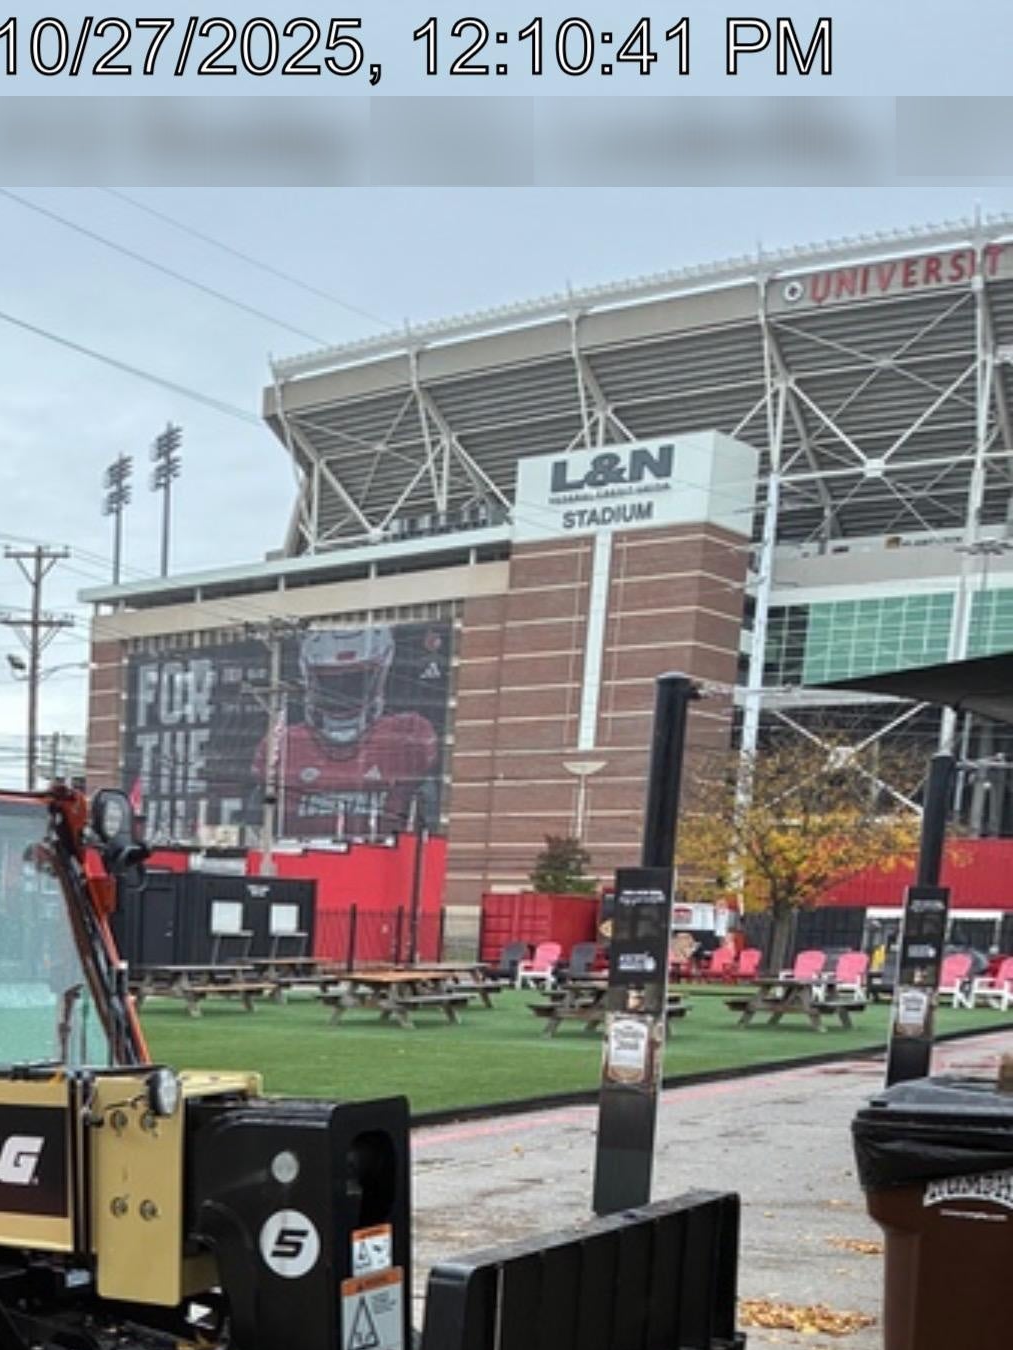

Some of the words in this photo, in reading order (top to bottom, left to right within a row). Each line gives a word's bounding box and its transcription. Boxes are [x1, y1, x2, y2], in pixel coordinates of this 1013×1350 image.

[551, 444, 675, 493] L&N
[562, 501, 654, 529] STADIUM
[136, 728, 210, 795] THE
